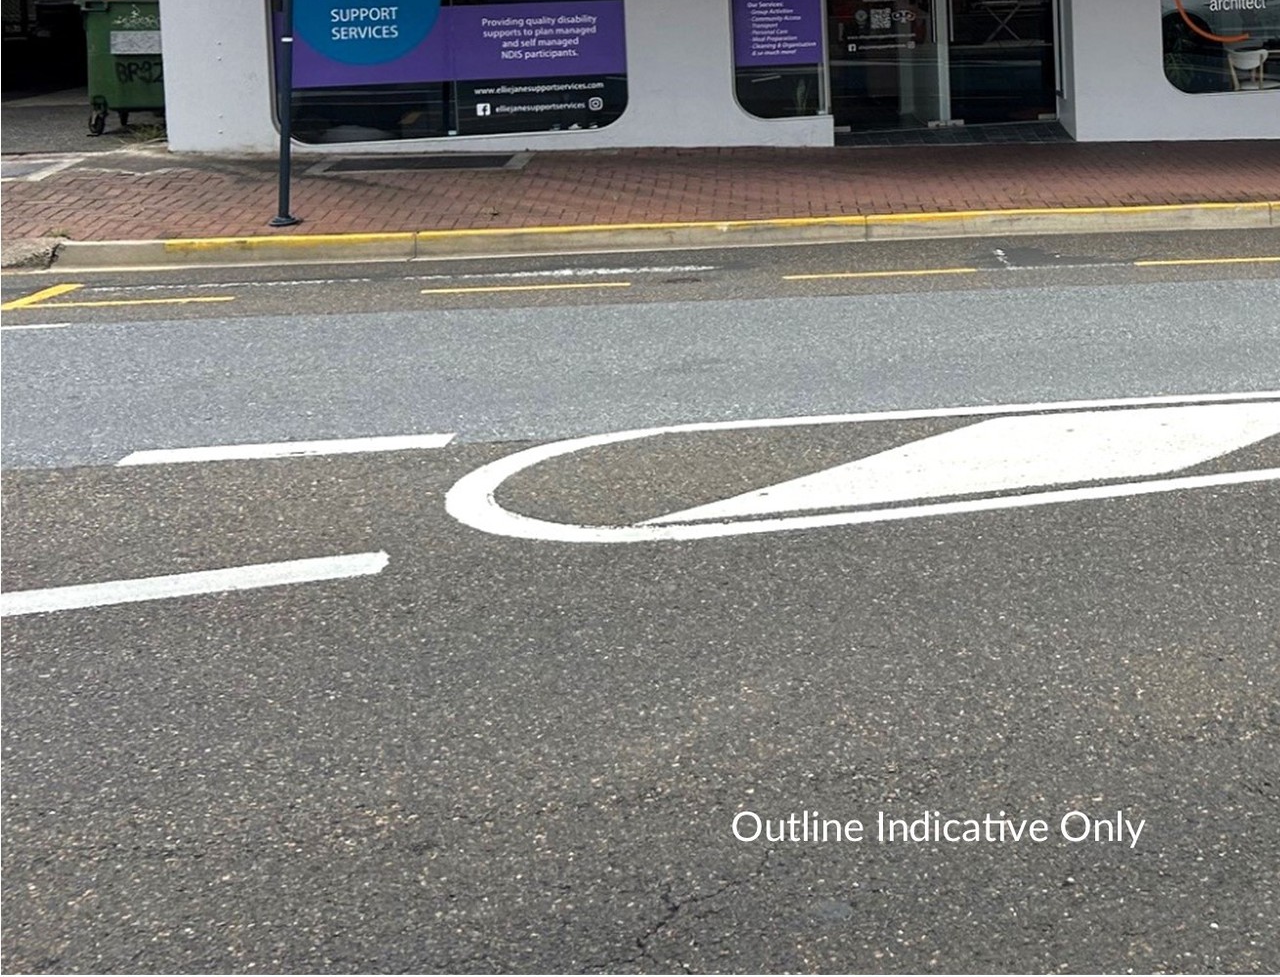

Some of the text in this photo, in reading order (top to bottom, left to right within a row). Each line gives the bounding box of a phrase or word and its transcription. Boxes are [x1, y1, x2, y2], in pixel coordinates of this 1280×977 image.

[330, 7, 398, 22] SUPPORT
[481, 14, 597, 27] Providing quality disability
[331, 25, 399, 40] SERVICES
[482, 29, 522, 38] supports
[535, 27, 554, 36] plan
[555, 25, 597, 36] managed
[502, 36, 579, 48] and self managed
[501, 49, 579, 60] NDIS participants.
